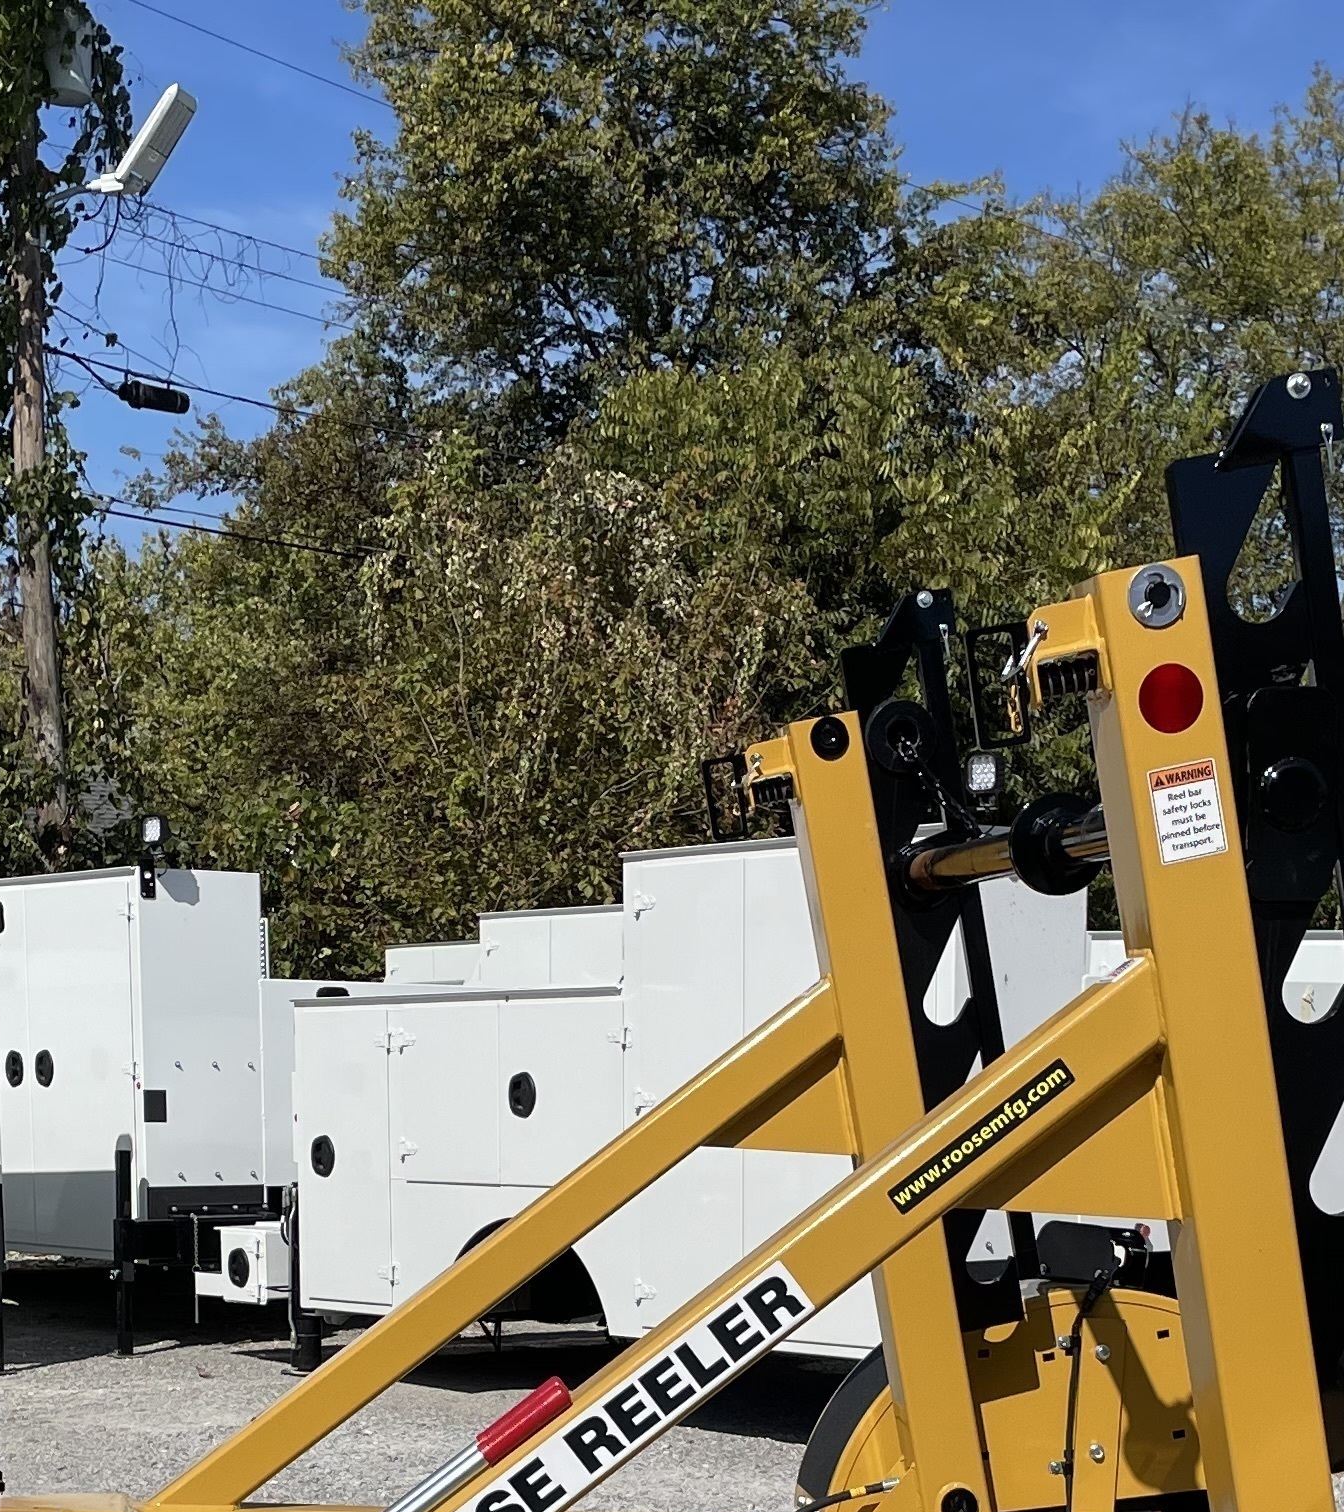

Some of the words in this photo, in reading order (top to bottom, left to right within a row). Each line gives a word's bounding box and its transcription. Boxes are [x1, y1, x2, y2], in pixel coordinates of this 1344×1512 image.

[1165, 765, 1212, 785] WARNING
[1167, 790, 1186, 802] Reel
[1188, 788, 1202, 798] bar
[1162, 804, 1188, 816] safety
[1190, 799, 1212, 810] locks
[1171, 815, 1194, 826] must
[1195, 812, 1207, 821] be
[1161, 827, 1191, 843] pinned
[1193, 823, 1221, 834] before
[1172, 836, 1214, 851] transport.
[893, 1067, 1067, 1205] www.roosemfg.com
[562, 1275, 806, 1475] REELER
